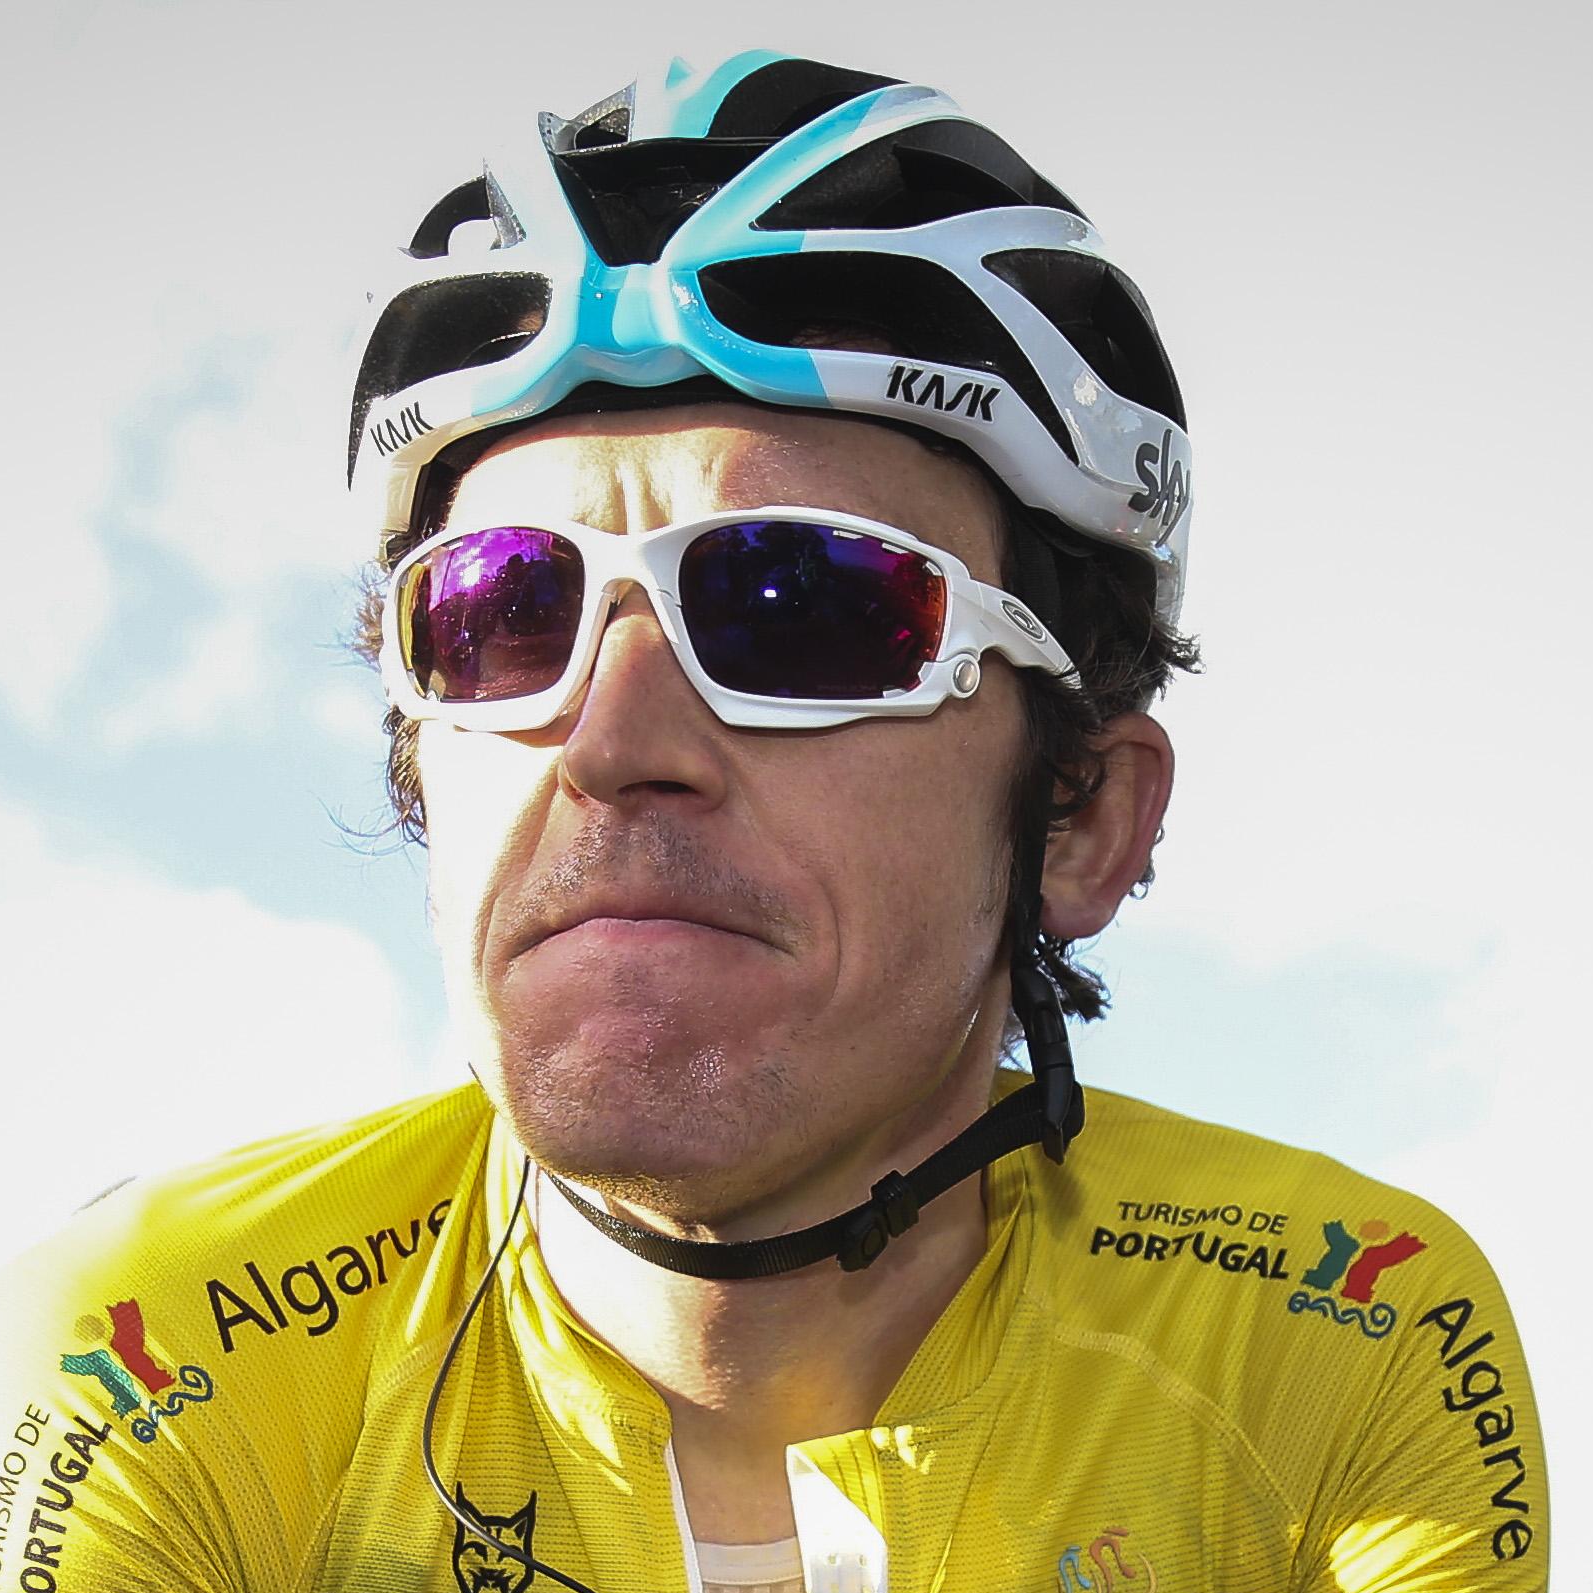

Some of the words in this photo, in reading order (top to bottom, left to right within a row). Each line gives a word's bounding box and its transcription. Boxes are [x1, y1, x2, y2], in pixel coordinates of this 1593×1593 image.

[886, 365, 1001, 422] KASK
[370, 401, 434, 457] KASK
[1118, 1201, 1244, 1227] TURISMO
[1247, 1211, 1290, 1236] DE
[205, 1198, 455, 1353] Algarve
[1089, 1226, 1290, 1280] PORTUGAL
[13, 1403, 51, 1447] DE
[1414, 1297, 1534, 1560] Algarve
